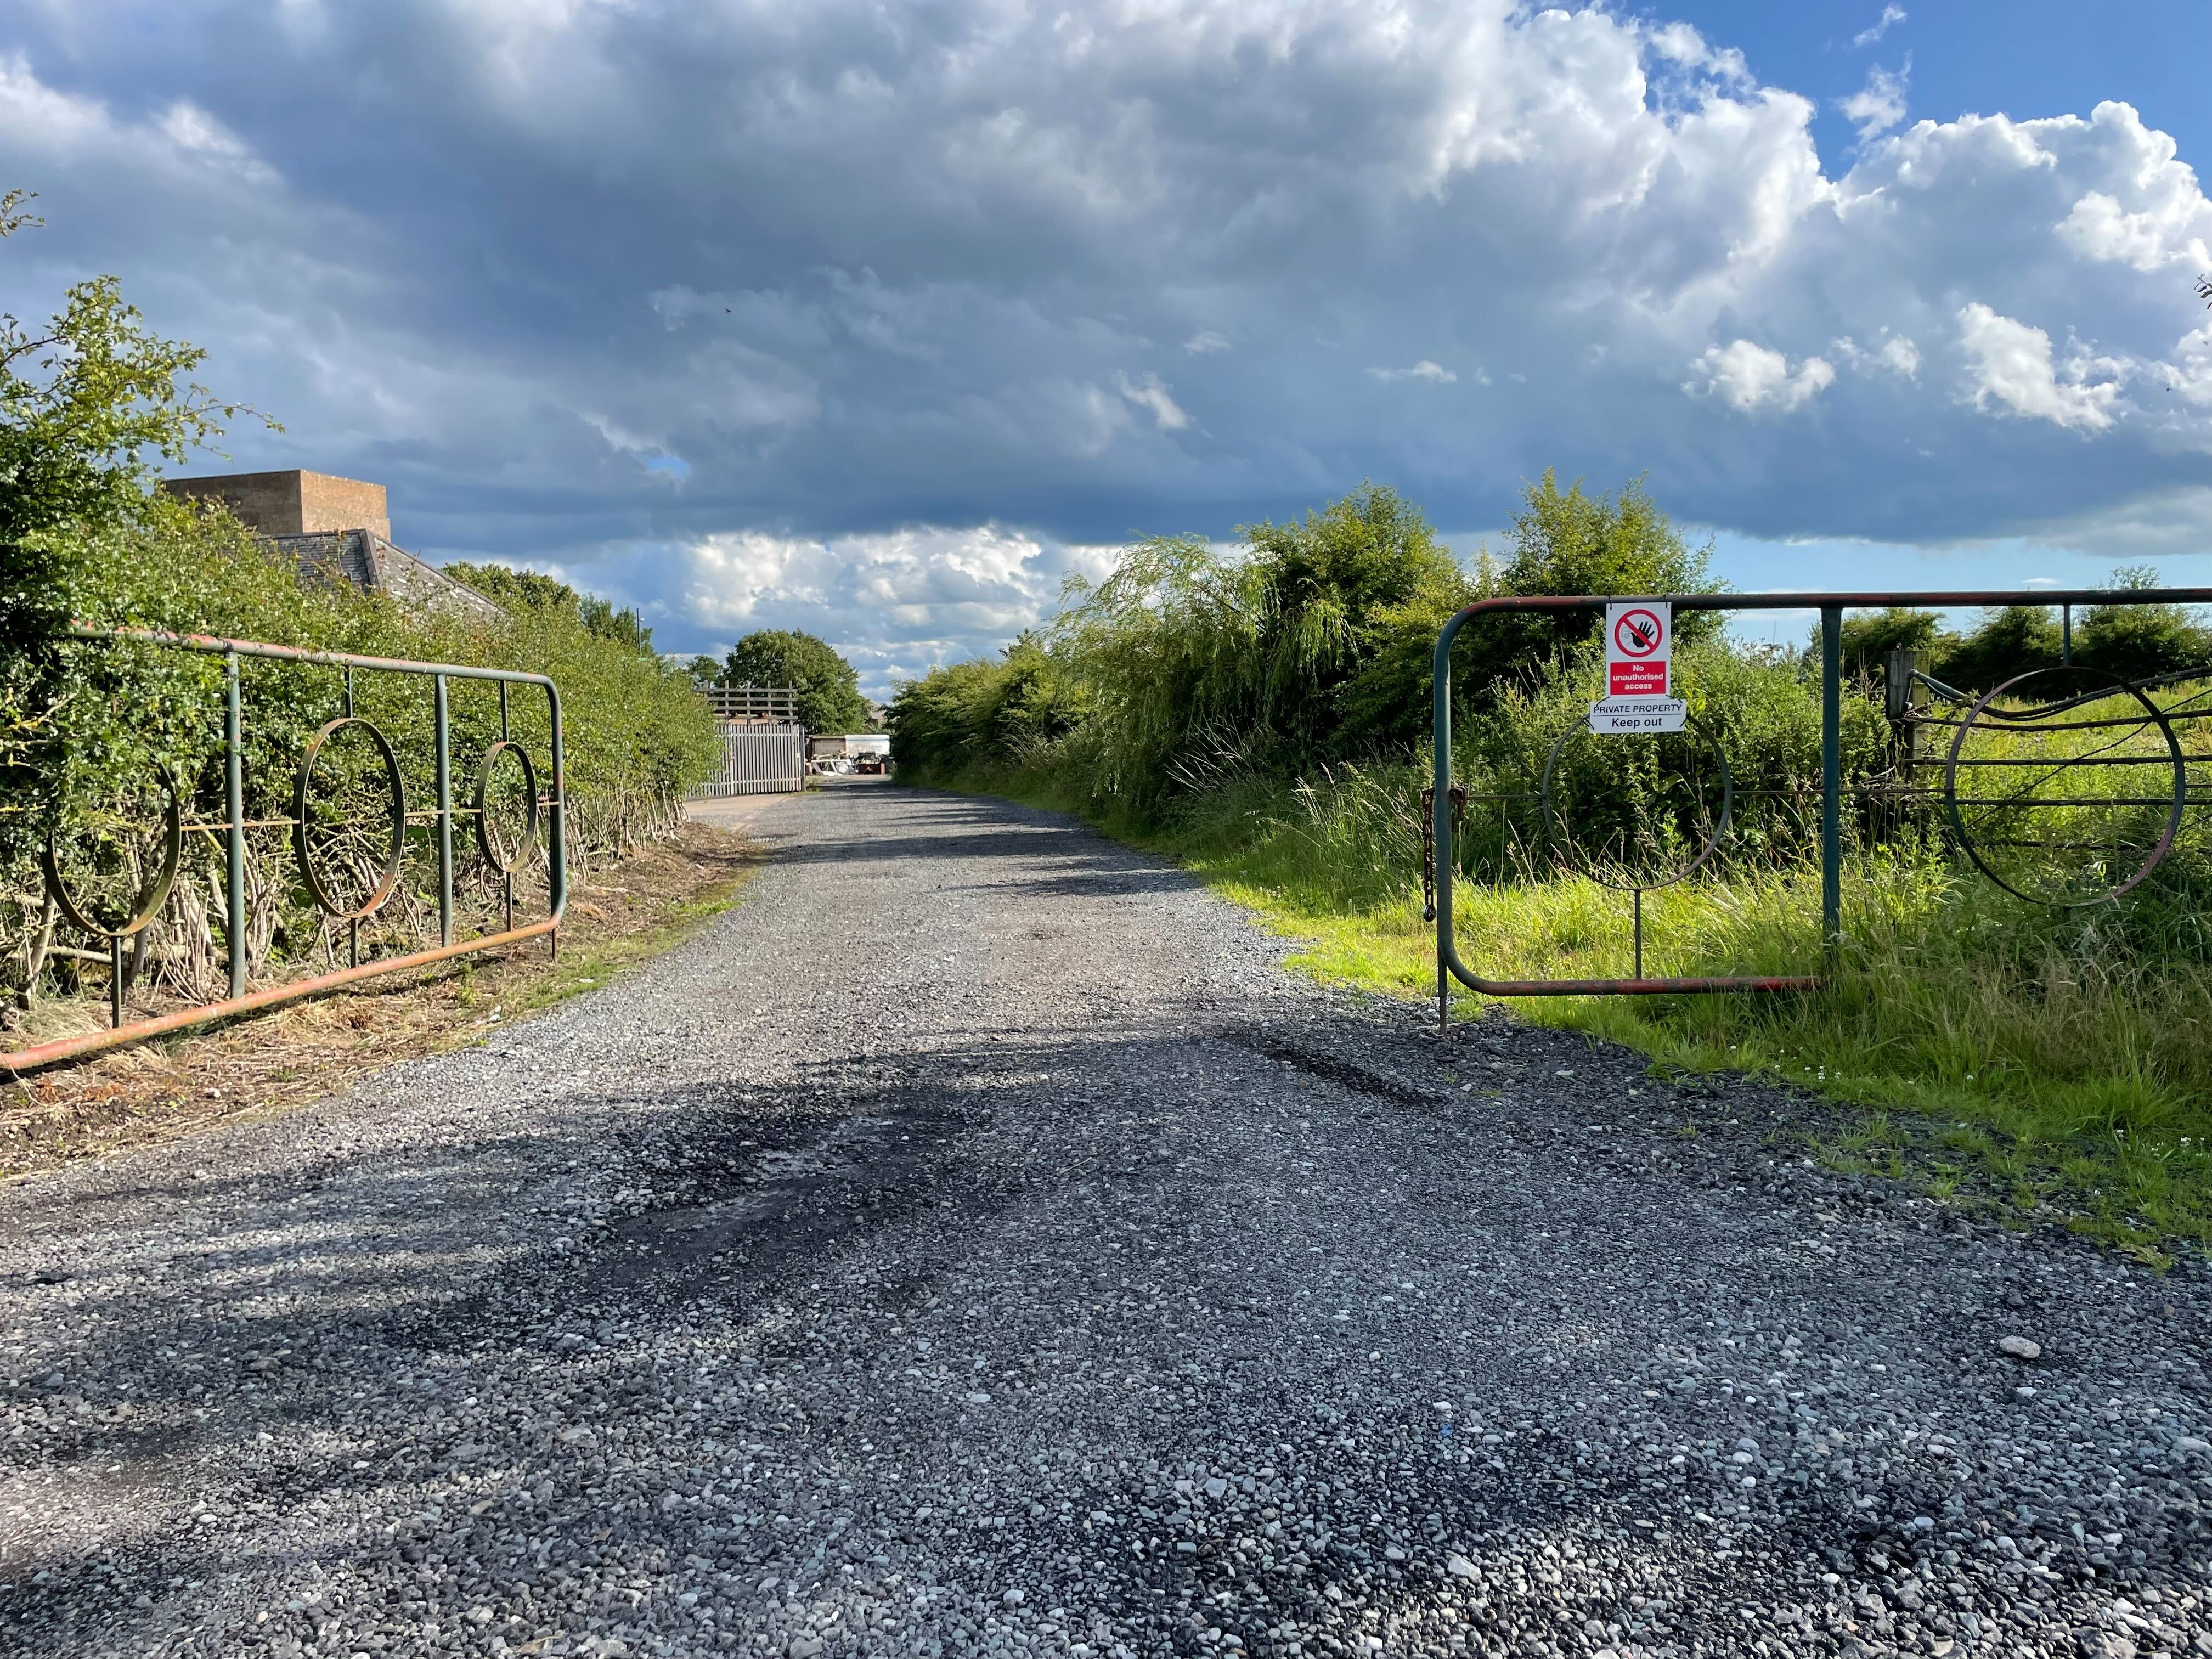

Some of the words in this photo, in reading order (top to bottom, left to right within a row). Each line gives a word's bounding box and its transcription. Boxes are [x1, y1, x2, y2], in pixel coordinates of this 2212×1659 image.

[1613, 673, 1663, 681] unauthorised
[1612, 718, 1640, 729] Keep
[1644, 718, 1662, 726] out
